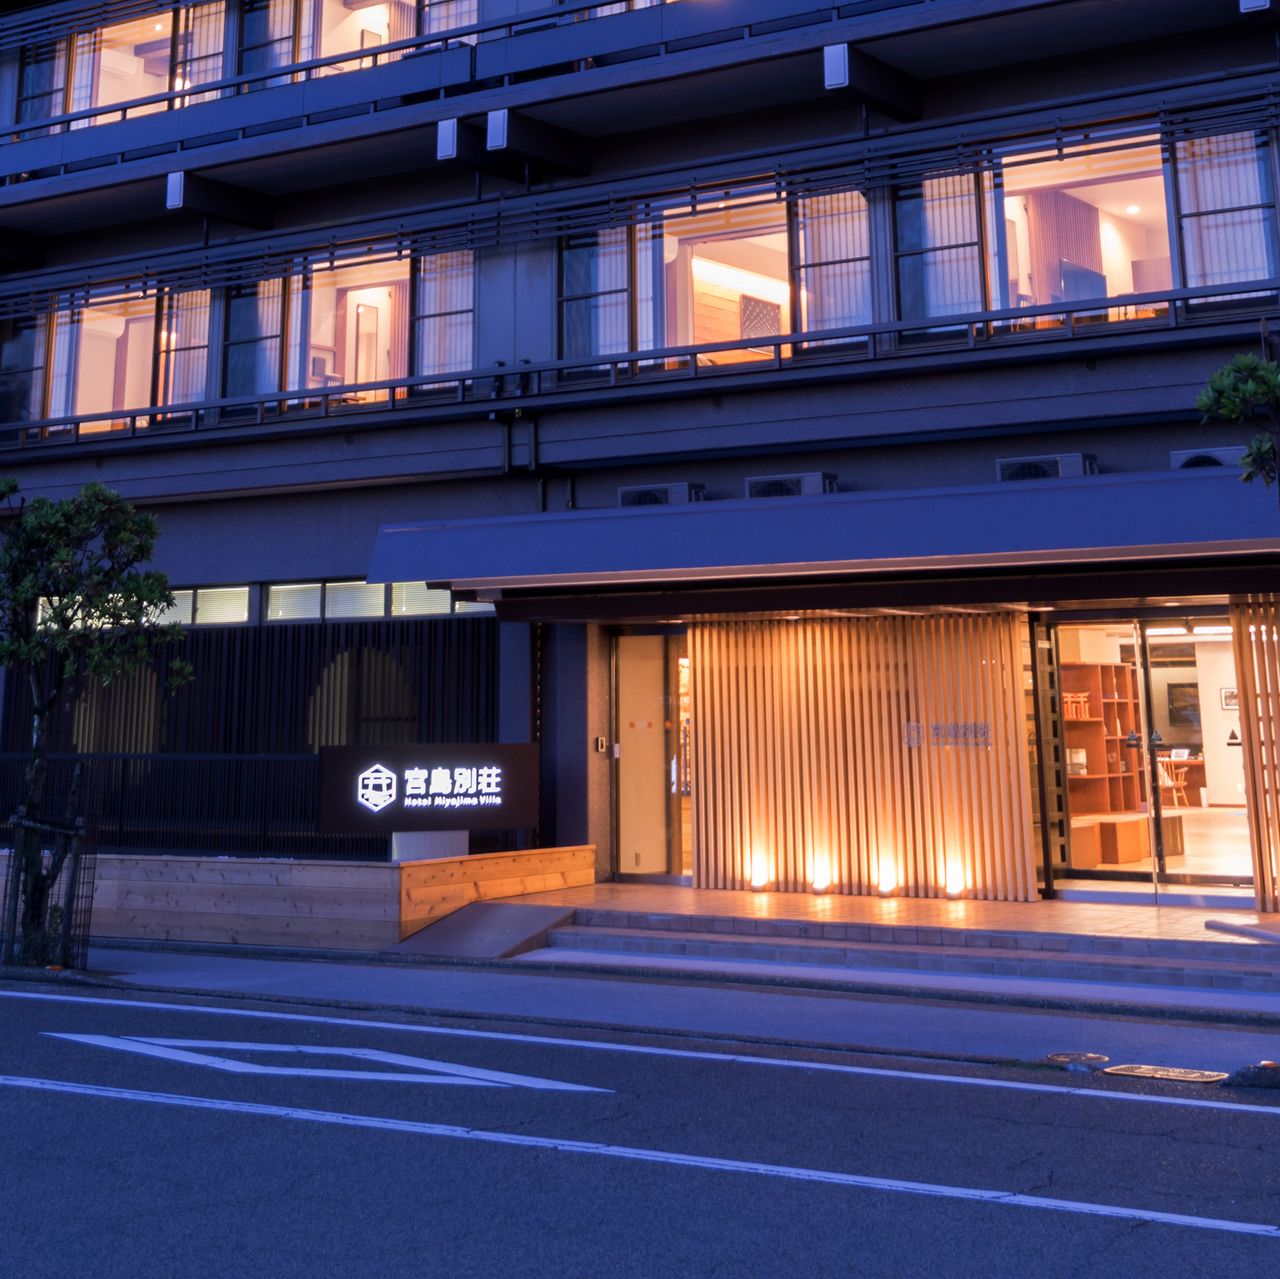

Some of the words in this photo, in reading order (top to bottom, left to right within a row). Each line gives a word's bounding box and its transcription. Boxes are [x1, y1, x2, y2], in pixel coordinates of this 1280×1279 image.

[404, 766, 502, 795] 宮島別荘
[404, 796, 432, 808] Hotel
[434, 795, 478, 808] Miyajima
[479, 794, 502, 806] Villa
